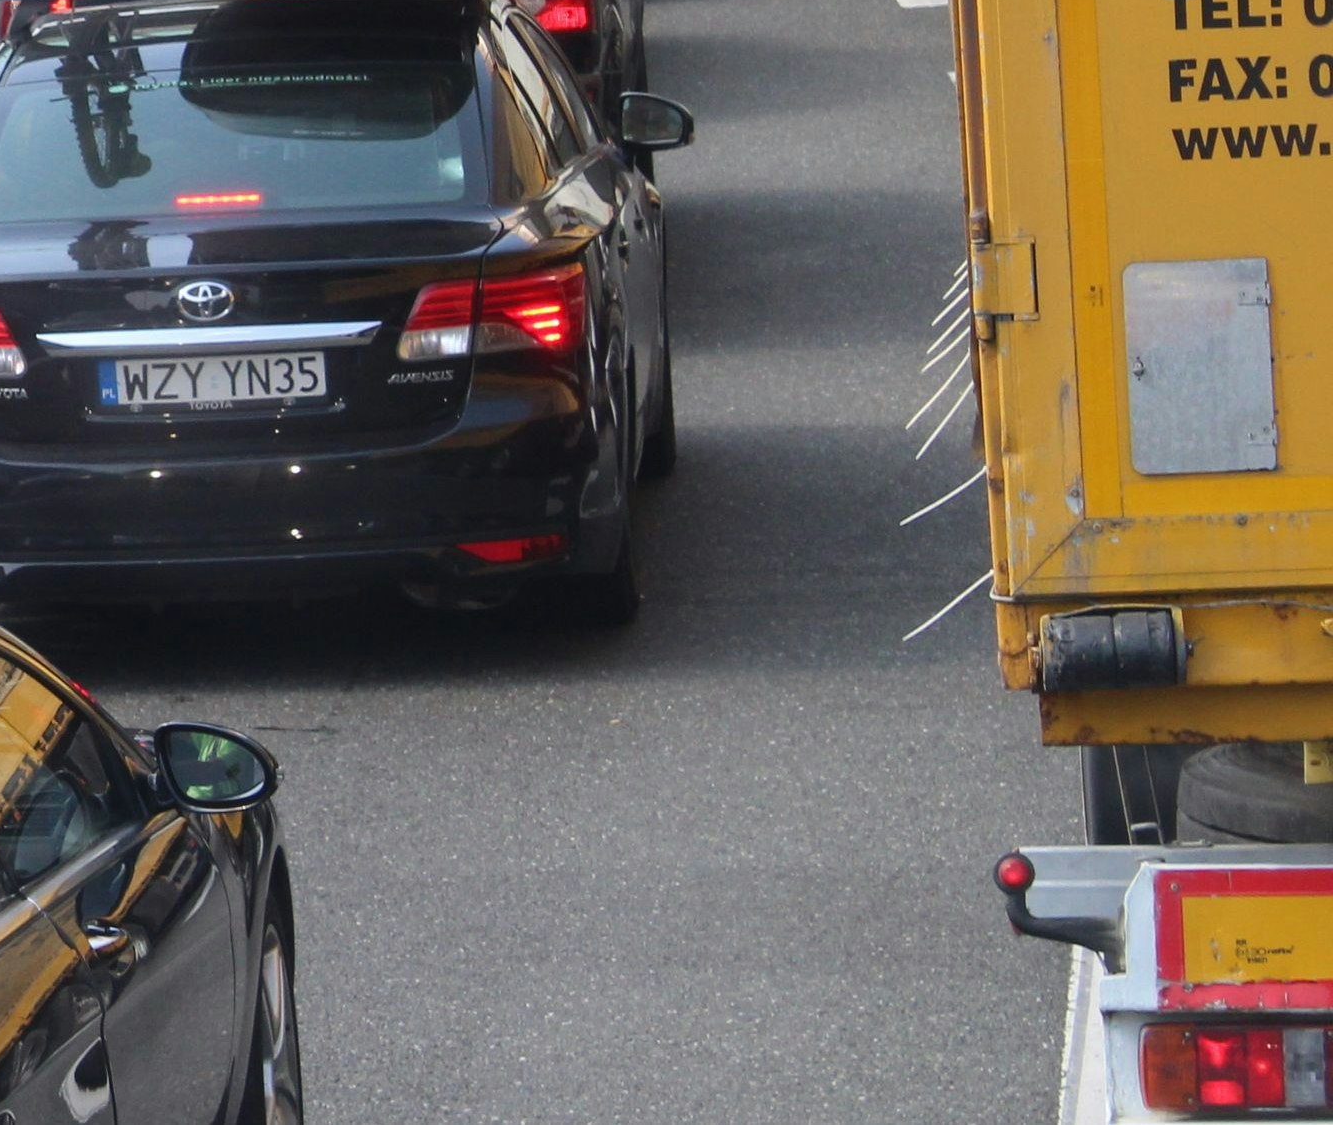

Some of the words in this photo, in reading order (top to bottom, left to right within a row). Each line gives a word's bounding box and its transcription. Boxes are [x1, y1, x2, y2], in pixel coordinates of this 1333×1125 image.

[1169, 56, 1288, 102] FAX:
[102, 388, 116, 400] PL
[122, 360, 205, 402] WZY
[221, 356, 319, 397] YN35
[388, 369, 454, 385] AVENSIS
[189, 400, 234, 411] TOYOTA
